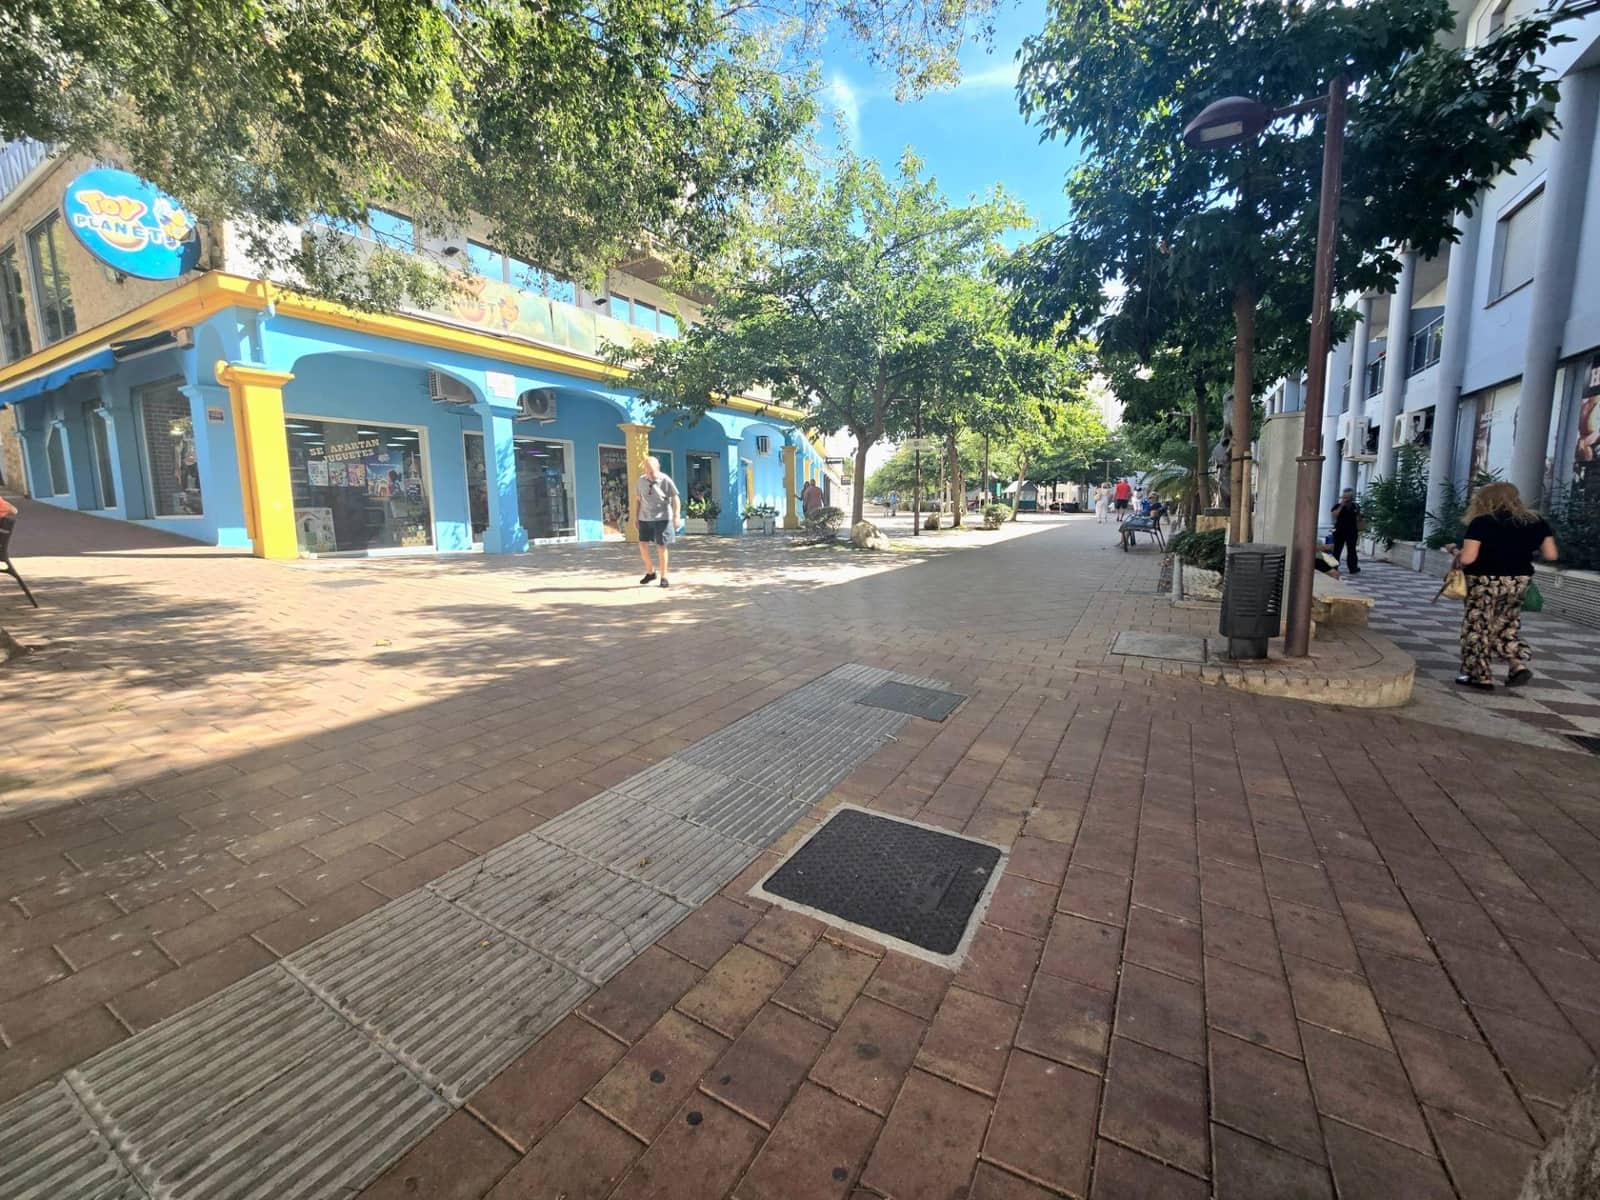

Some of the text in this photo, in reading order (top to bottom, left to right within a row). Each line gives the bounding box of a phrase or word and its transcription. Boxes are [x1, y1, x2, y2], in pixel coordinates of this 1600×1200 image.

[78, 191, 146, 222] TOY
[76, 214, 161, 244] PLANET
[309, 447, 324, 456] SE
[322, 448, 375, 464] JUGUETES
